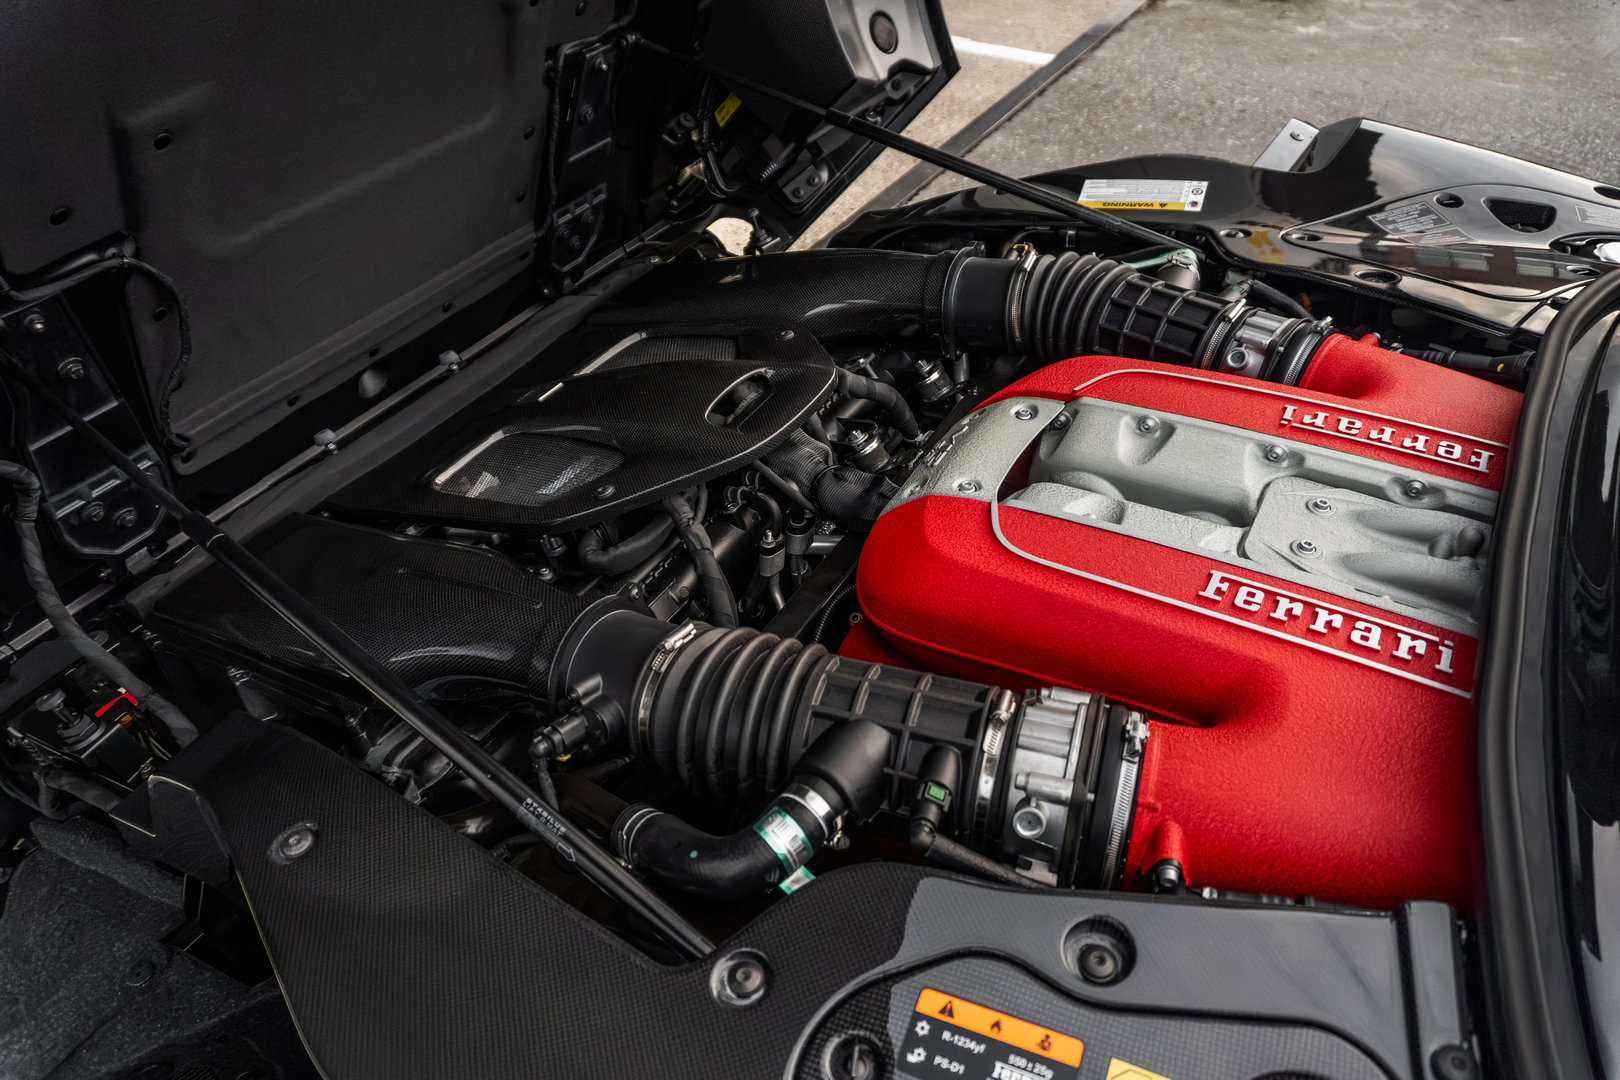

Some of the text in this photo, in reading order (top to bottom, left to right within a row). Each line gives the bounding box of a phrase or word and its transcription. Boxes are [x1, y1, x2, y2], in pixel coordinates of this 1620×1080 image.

[1280, 404, 1495, 473] Ferrari
[1198, 569, 1455, 674] Ferrari
[525, 797, 567, 833] STABILUS
[941, 1030, 987, 1054] R-1234yf
